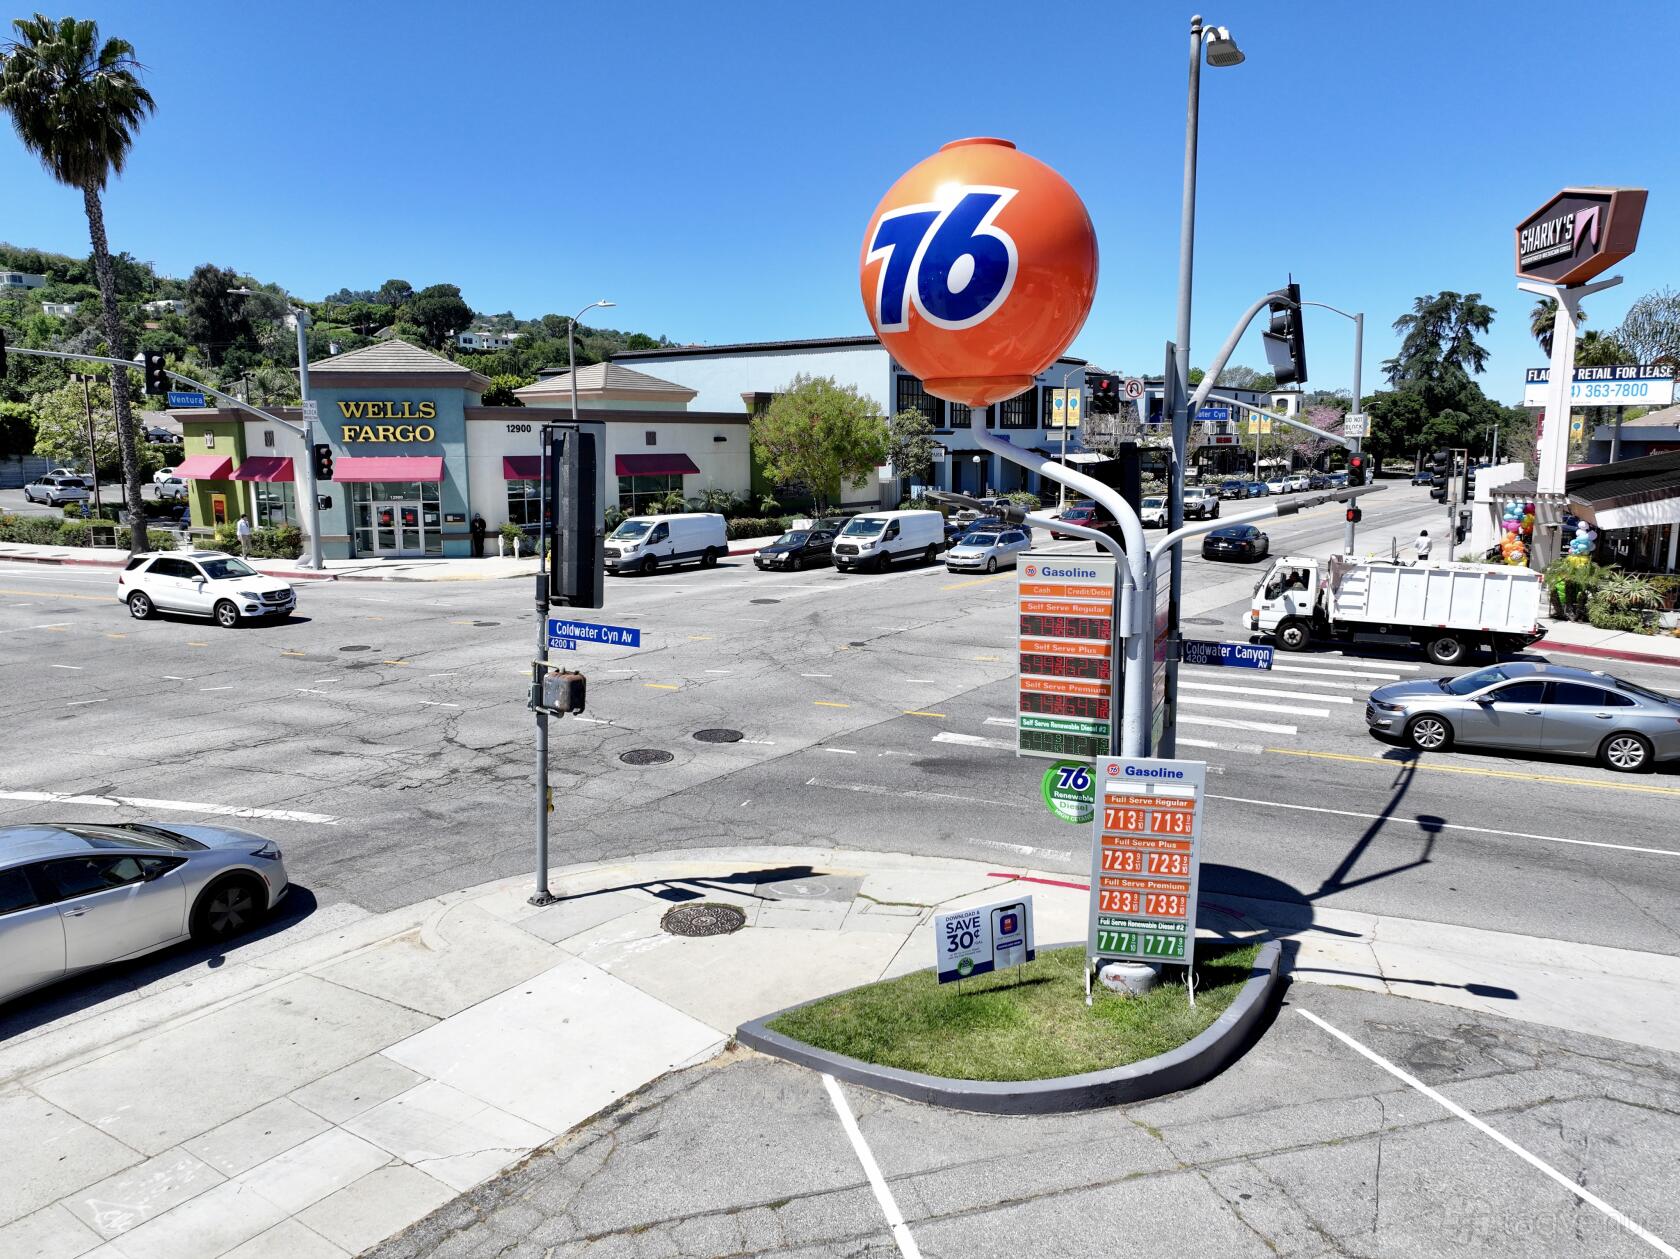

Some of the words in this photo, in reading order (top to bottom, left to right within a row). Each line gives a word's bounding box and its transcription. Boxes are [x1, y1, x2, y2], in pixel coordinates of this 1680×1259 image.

[1520, 213, 1574, 254] SHARKY'S
[864, 184, 1018, 332] 76
[1578, 368, 1613, 380] RETAIL
[1616, 367, 1636, 379] FOR
[1640, 366, 1674, 378] LEASE
[1585, 383, 1648, 397] 363-7800
[170, 394, 203, 404] Ventura
[336, 400, 436, 418] WELLS
[1213, 411, 1226, 420] Cyn
[340, 424, 436, 442] FARGO
[506, 424, 532, 433] 12900
[1042, 566, 1096, 578] Gasoline
[1072, 605, 1105, 613] Regular
[556, 622, 598, 638] Coldwater
[602, 628, 618, 644] Cyn
[622, 630, 632, 642] Av
[550, 639, 567, 648] 4200
[570, 640, 574, 648] N
[1079, 646, 1096, 654] Plus
[1186, 642, 1231, 657] Coldwater
[1235, 646, 1269, 662] Canyon
[1186, 655, 1207, 664] 4200
[1044, 683, 1066, 691] Serve
[1069, 685, 1107, 694] Premium
[1034, 720, 1049, 728] Serve
[1051, 721, 1079, 730] Renewable
[1080, 724, 1098, 732] Diesel
[1098, 725, 1107, 733] #2
[1057, 766, 1091, 790] 76
[1125, 766, 1184, 779] Gasoline
[1054, 791, 1094, 802] Renewable
[1156, 798, 1188, 807] Regular
[1059, 802, 1088, 811] Diesel
[1106, 809, 1136, 829] 713
[1153, 813, 1183, 832] 713
[1132, 839, 1155, 847] Serve
[1104, 850, 1134, 870] 723
[1150, 853, 1180, 872] 723
[1148, 882, 1185, 890] Premium
[1101, 891, 1131, 911] 733
[1148, 895, 1177, 914] 733
[946, 912, 976, 922] DOWNLOAD
[946, 917, 980, 934] SAVE
[1128, 920, 1157, 929] Renewable
[1100, 932, 1129, 951] 777
[1146, 935, 1176, 955] 777
